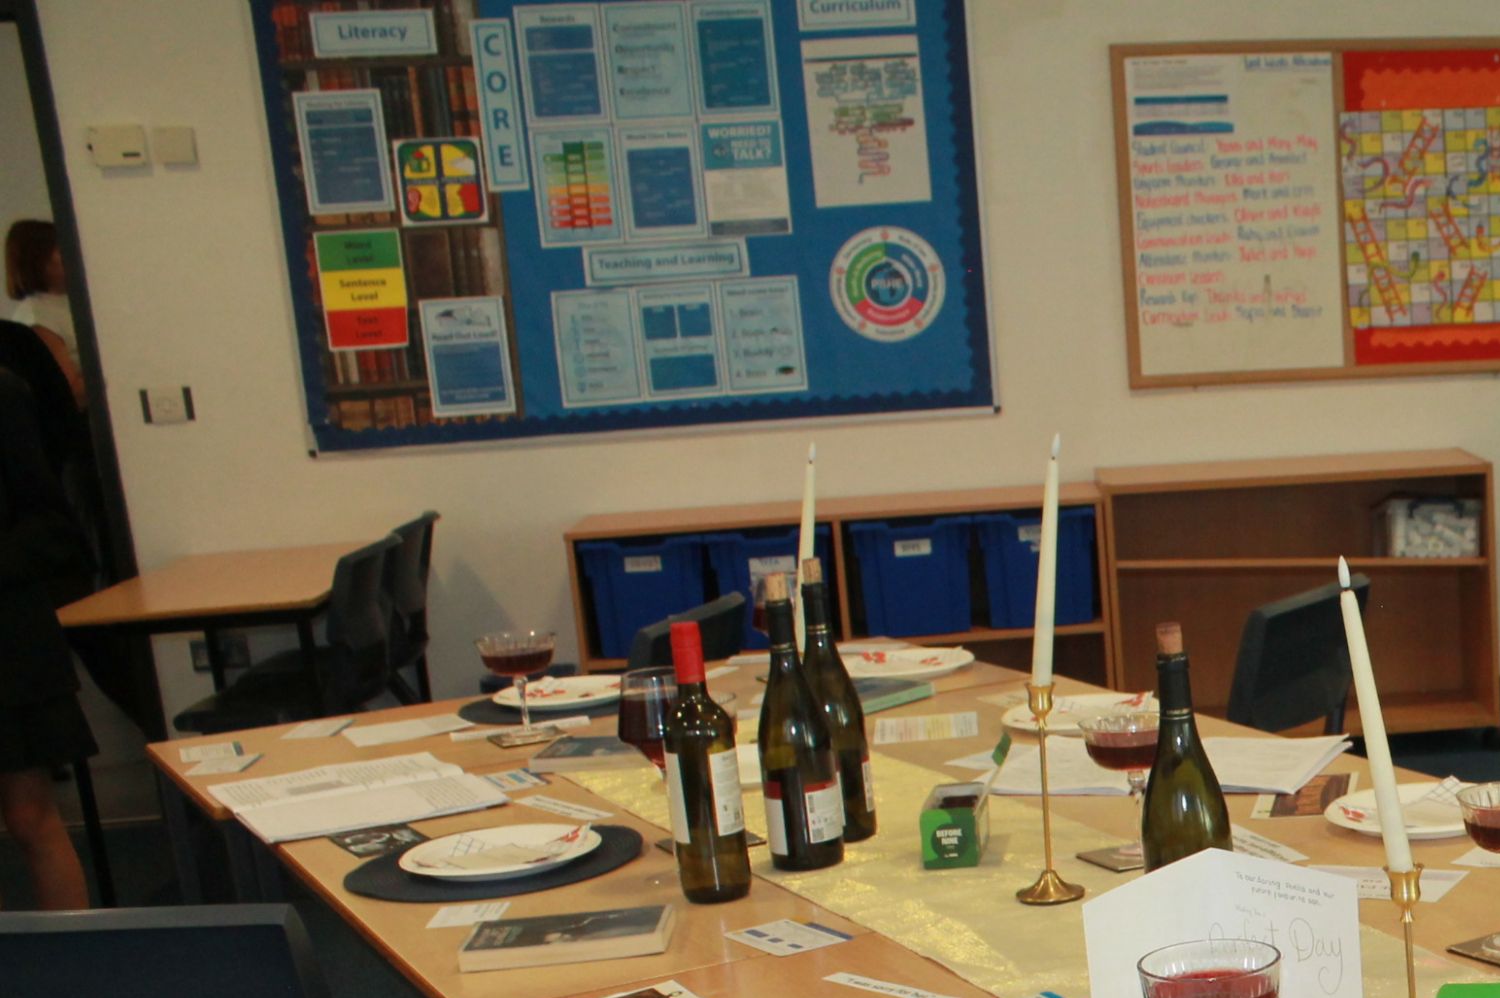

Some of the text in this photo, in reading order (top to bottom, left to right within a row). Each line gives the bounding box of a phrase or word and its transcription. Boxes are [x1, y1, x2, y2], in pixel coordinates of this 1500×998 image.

[337, 24, 408, 42] Literacy
[708, 125, 771, 139] WORRIED?
[733, 147, 771, 160] TALK?
[598, 252, 735, 271] Teaching and Learning
[350, 292, 378, 304] Level
[1289, 917, 1344, 996] Day
